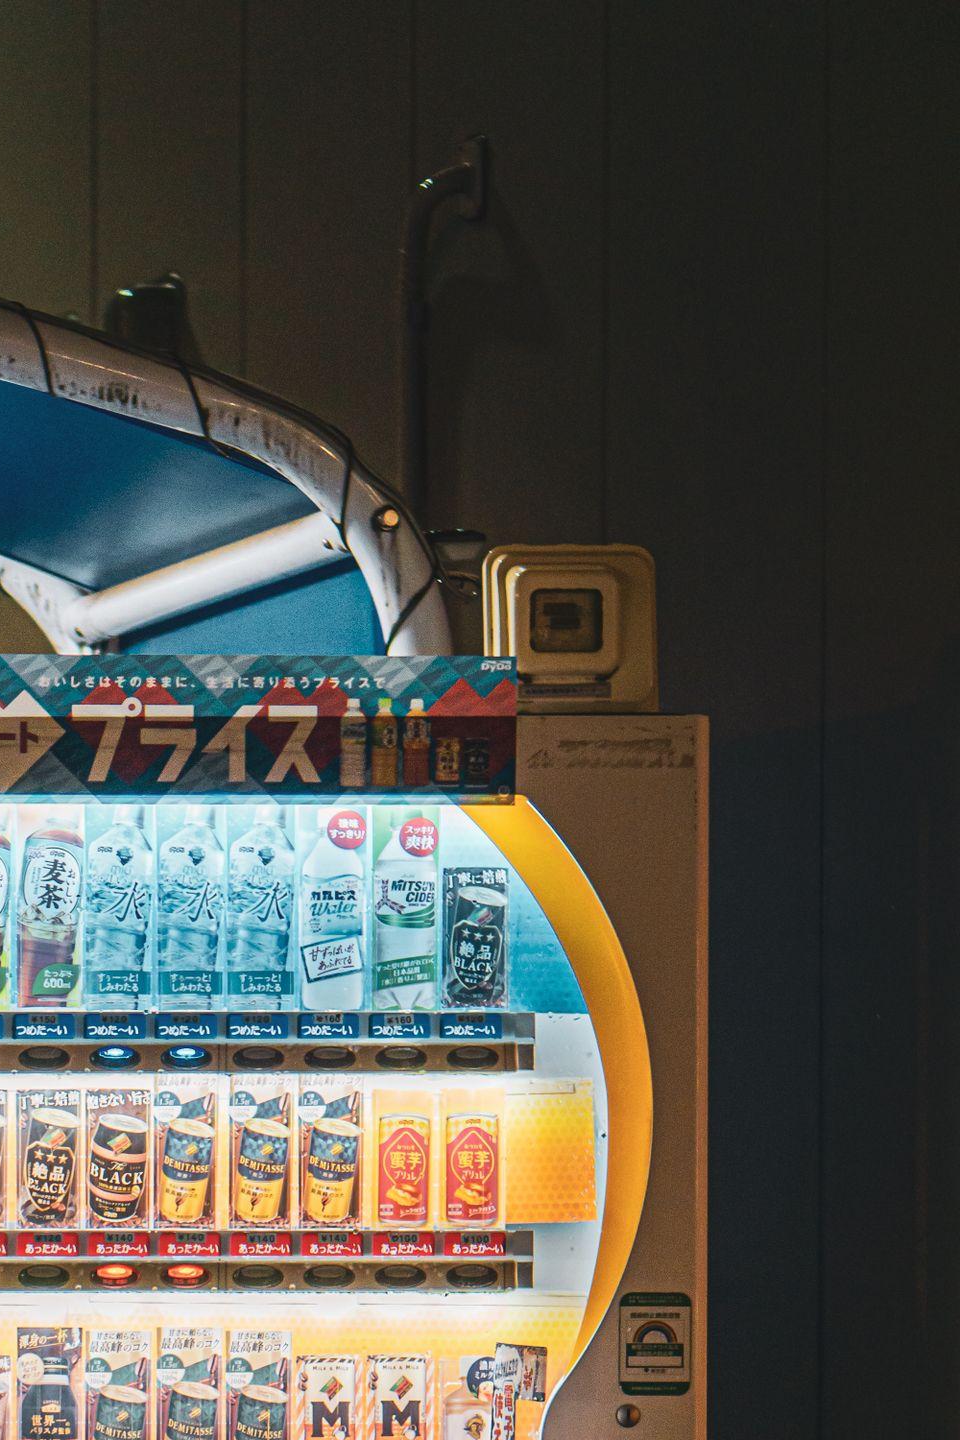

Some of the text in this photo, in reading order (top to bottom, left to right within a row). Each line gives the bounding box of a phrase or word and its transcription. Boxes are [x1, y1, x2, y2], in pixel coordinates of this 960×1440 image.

[71, 697, 321, 784] プライス
[405, 826, 434, 835] スッキリ
[406, 836, 434, 850] 爽快
[37, 859, 67, 909] 麦茶
[103, 882, 145, 922] 水
[176, 882, 217, 922] 水
[246, 882, 287, 922] 水
[311, 891, 358, 901] カルピス
[310, 901, 358, 916] Water
[458, 941, 492, 960] 絶品
[454, 957, 493, 973] BLACK
[98, 982, 139, 992] しみわたる
[171, 982, 212, 992] しみわたる
[241, 982, 281, 992] しみわたる
[164, 1156, 209, 1173] DEMITASSE
[240, 1156, 285, 1173] DEMITASSE
[310, 1156, 355, 1173] DEMITASSE
[390, 1151, 422, 1169] 蜜芋
[458, 1151, 490, 1169] 蜜芋
[32, 1162, 64, 1182] 絶品
[90, 1163, 144, 1185] BLACK
[90, 1341, 149, 1354] 最高峰のコク
[162, 1338, 220, 1350] 最高峰のコク
[230, 1341, 288, 1353] 最高峰のコク
[310, 1400, 351, 1437] M
[380, 1400, 421, 1436] M
[96, 1422, 142, 1439] DEMITASSE
[168, 1418, 213, 1436] DEMITASSE
[237, 1422, 282, 1439] DEMITASSE
